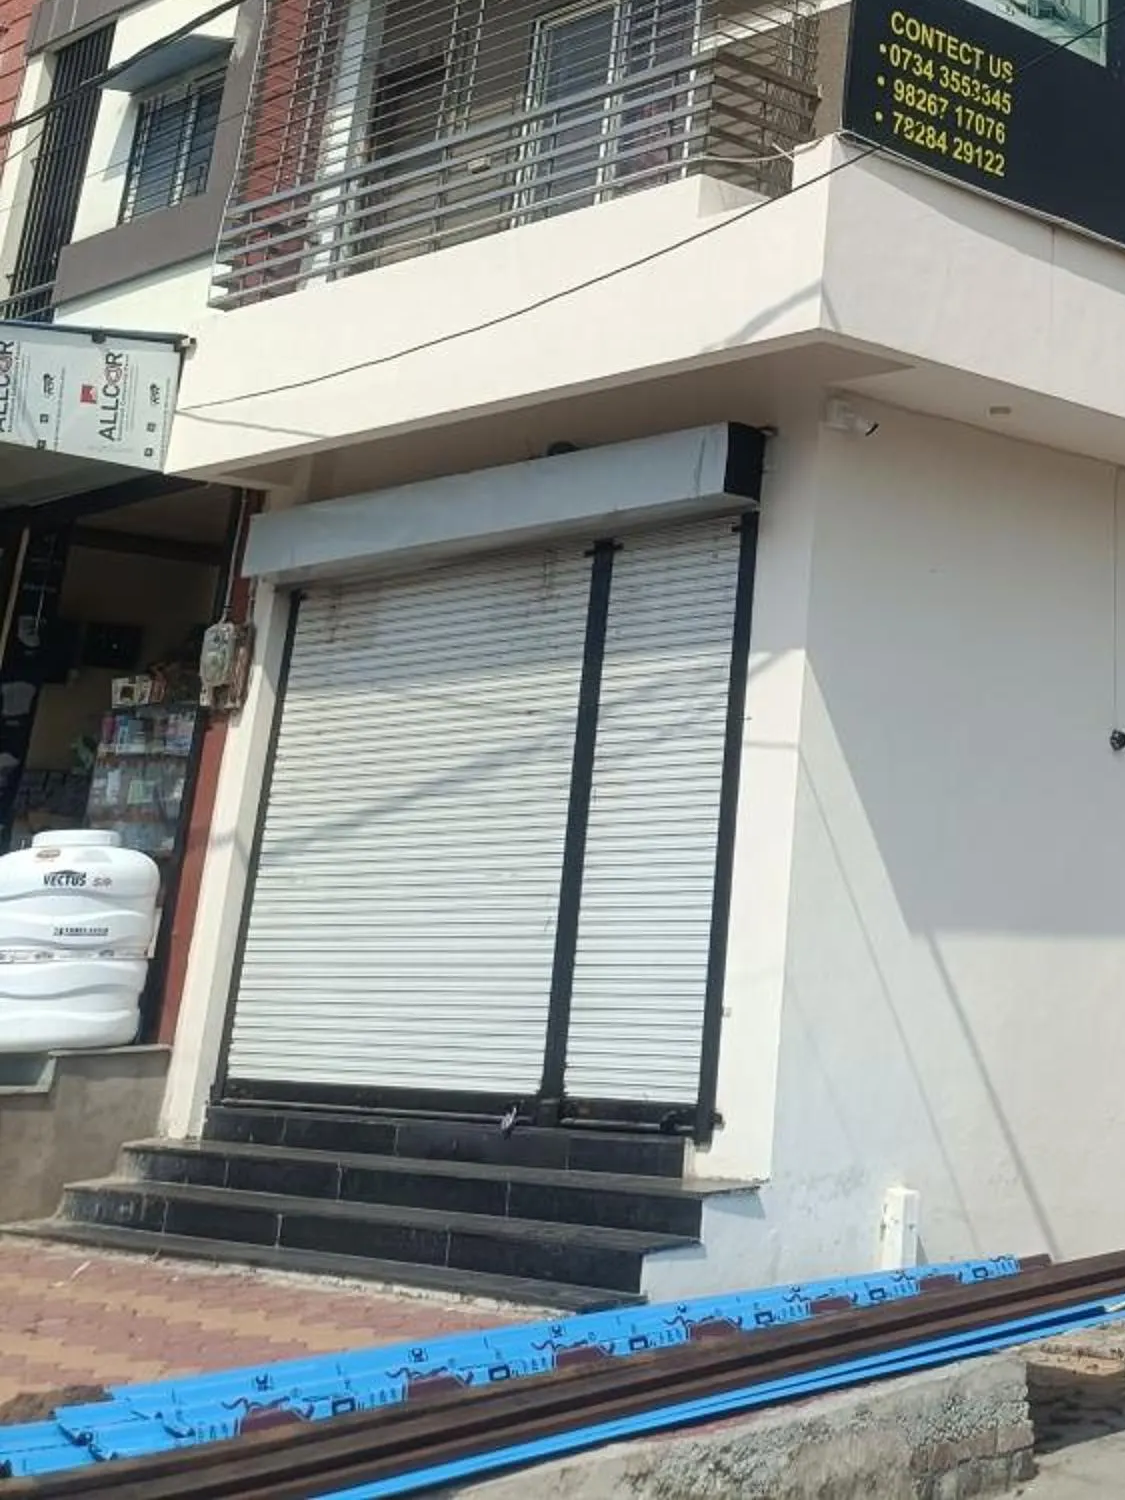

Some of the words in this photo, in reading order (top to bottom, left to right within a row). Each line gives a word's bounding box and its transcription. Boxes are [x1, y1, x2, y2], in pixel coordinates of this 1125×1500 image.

[889, 43, 935, 82] 0734
[938, 64, 1012, 115] 3553345
[890, 11, 985, 71] CONTECT
[988, 54, 1014, 84] US
[892, 111, 948, 153] 78284
[953, 137, 1006, 177] 29122
[893, 79, 949, 119] 98267
[955, 105, 1006, 145] 17076
[98, 352, 124, 442] ALLCOR
[43, 872, 87, 887] VECTUS
